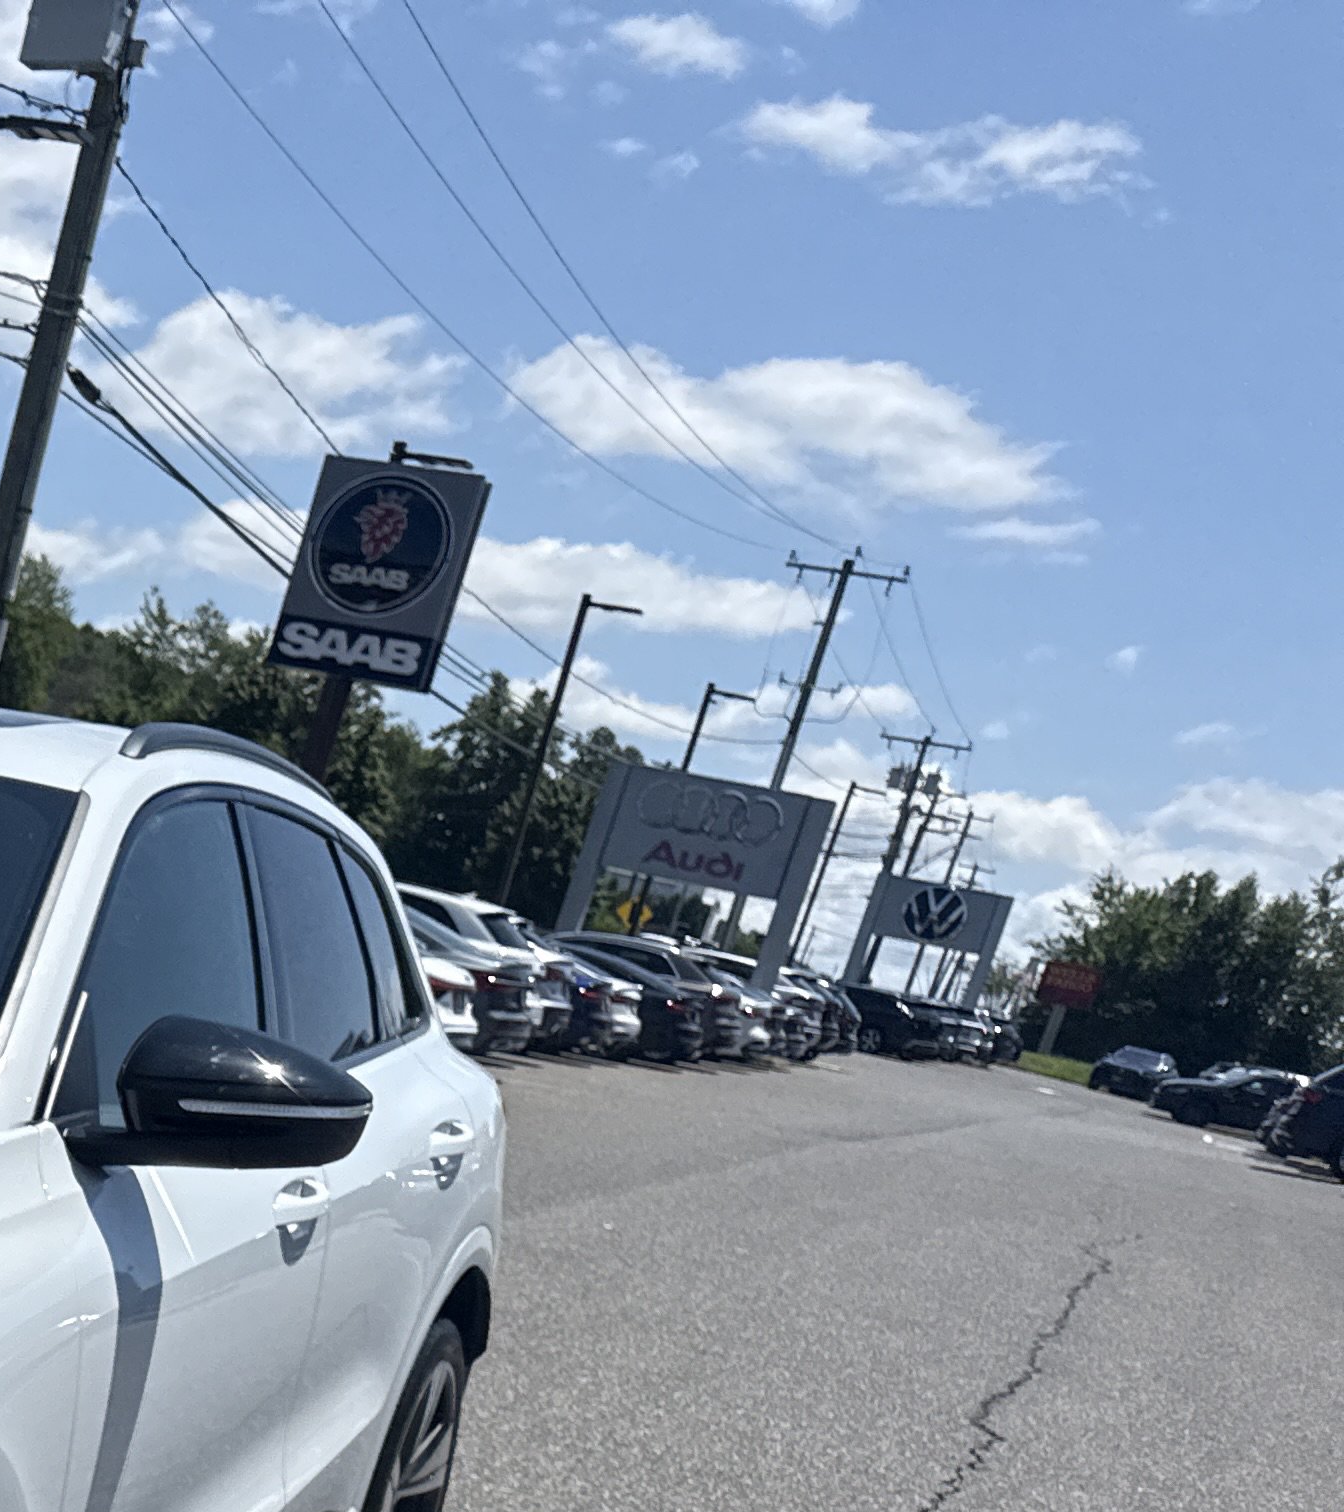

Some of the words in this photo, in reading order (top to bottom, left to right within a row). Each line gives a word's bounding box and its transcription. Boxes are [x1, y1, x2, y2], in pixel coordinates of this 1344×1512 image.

[328, 563, 410, 591] SAAB
[277, 621, 422, 677] SAAB
[641, 839, 745, 881] Audi
